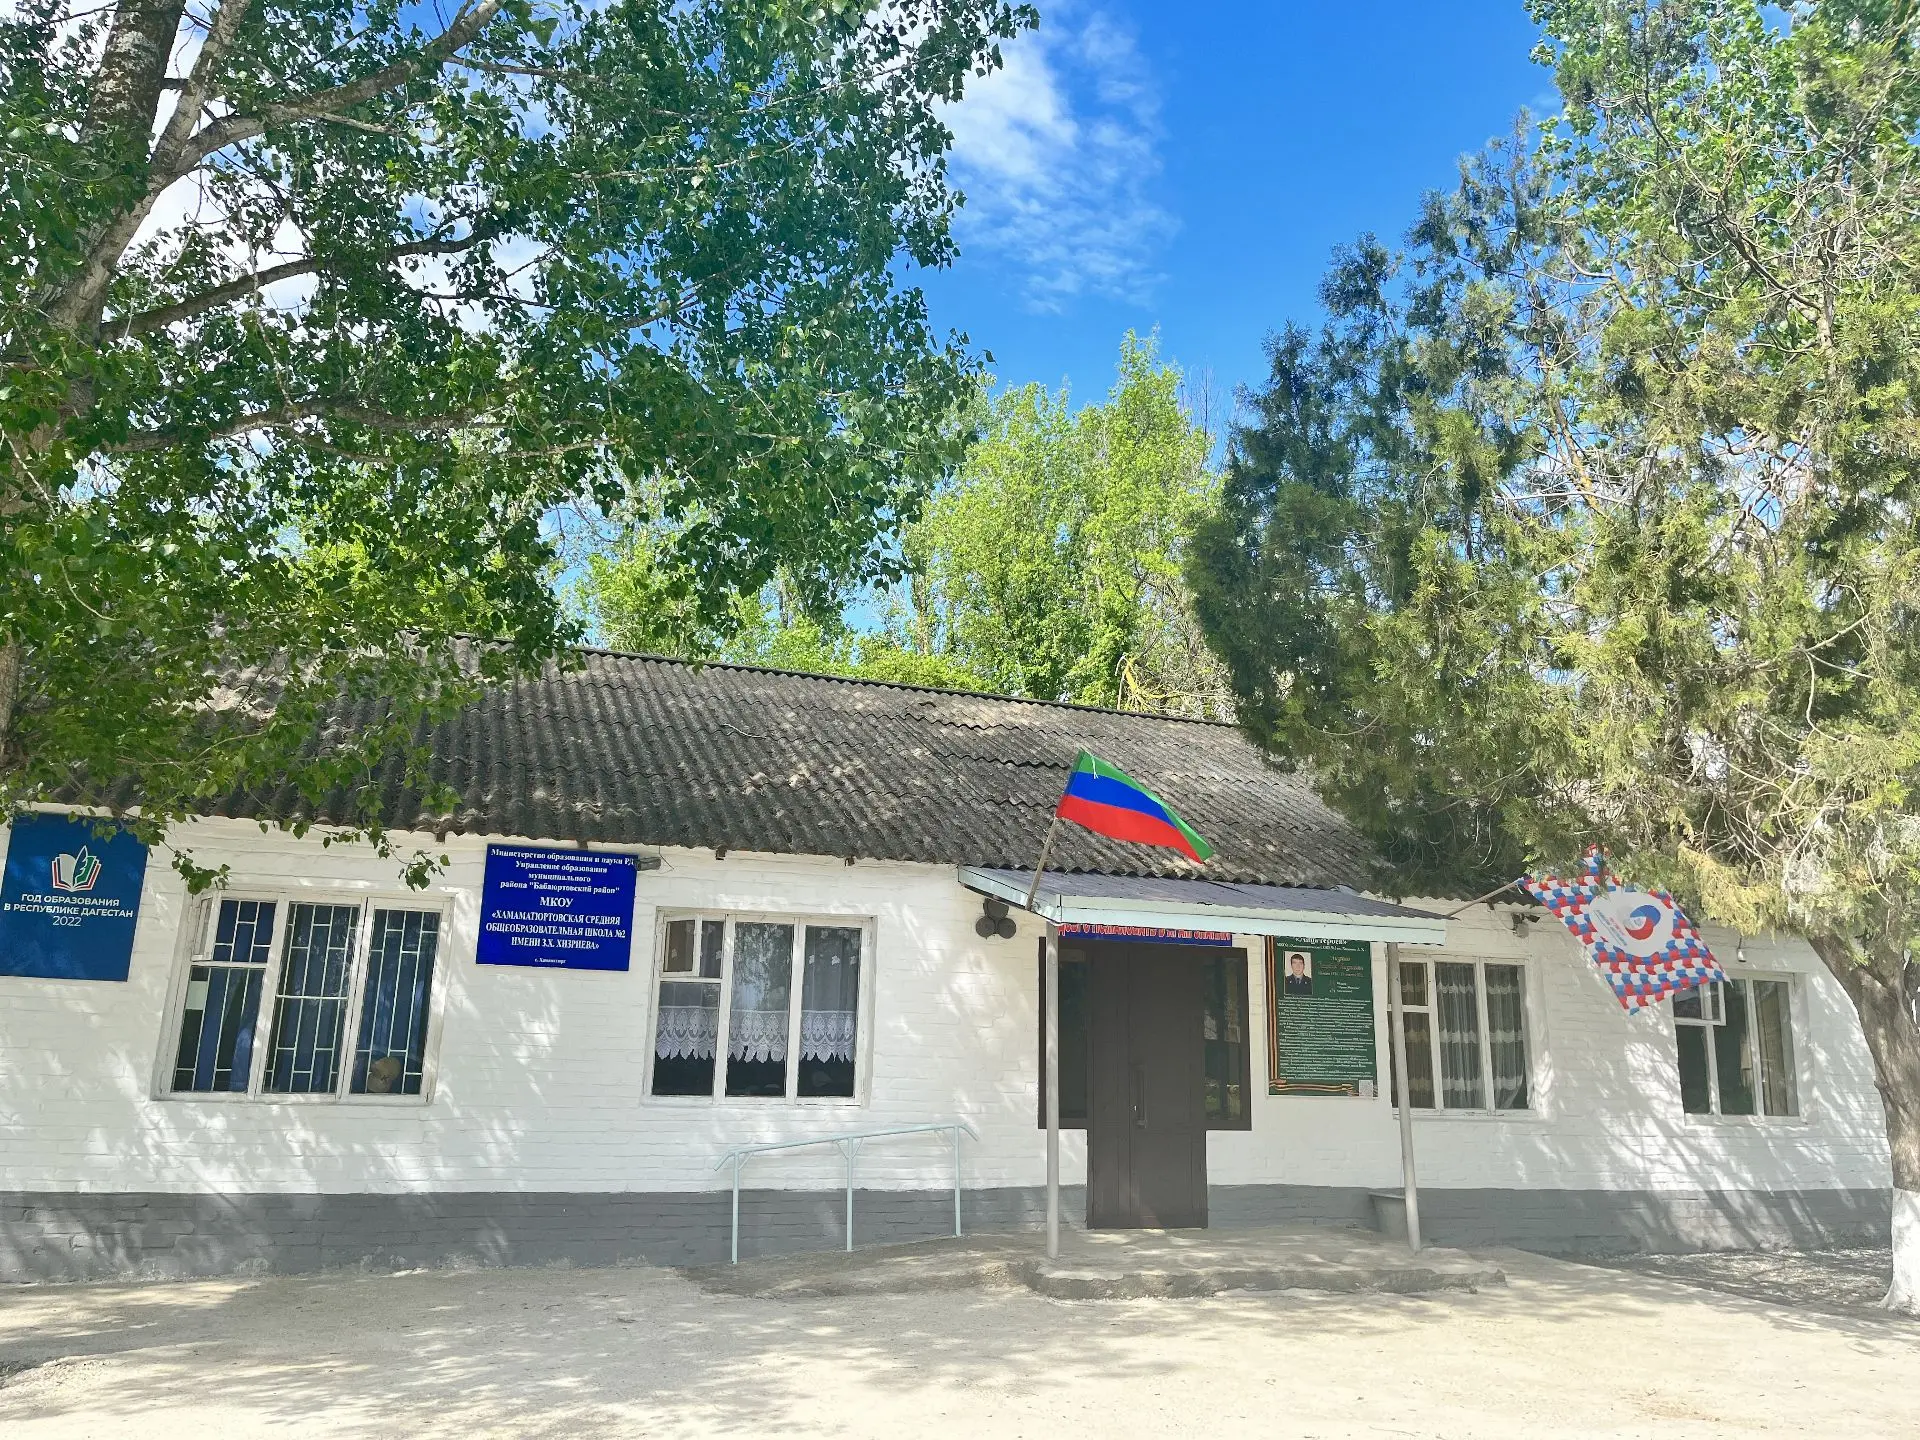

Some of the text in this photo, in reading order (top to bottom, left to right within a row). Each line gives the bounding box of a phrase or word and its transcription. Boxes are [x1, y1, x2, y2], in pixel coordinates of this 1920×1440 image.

[491, 848, 546, 860] Министерство
[547, 852, 593, 863] образования
[601, 857, 623, 866] науки
[515, 860, 608, 874] Управление образования
[528, 872, 591, 882] муниципального
[500, 880, 528, 889] района
[21, 893, 120, 906] ГОД ОБРАЗОВАНИЯ
[539, 896, 574, 908] МКОУ
[3, 903, 134, 918] В РЕСПУБЛИКЕ ДАГЕСТАН
[52, 915, 82, 927] 2022
[491, 909, 621, 926] «ХАМАМАТЮРТОВСКАЯ СРЕДНЯЯ
[486, 922, 626, 939] ОБЩЕОБРАЗОВАТЕЛЬНАЯ ШКОЛА №2
[511, 936, 541, 947] ИМЕНИ
